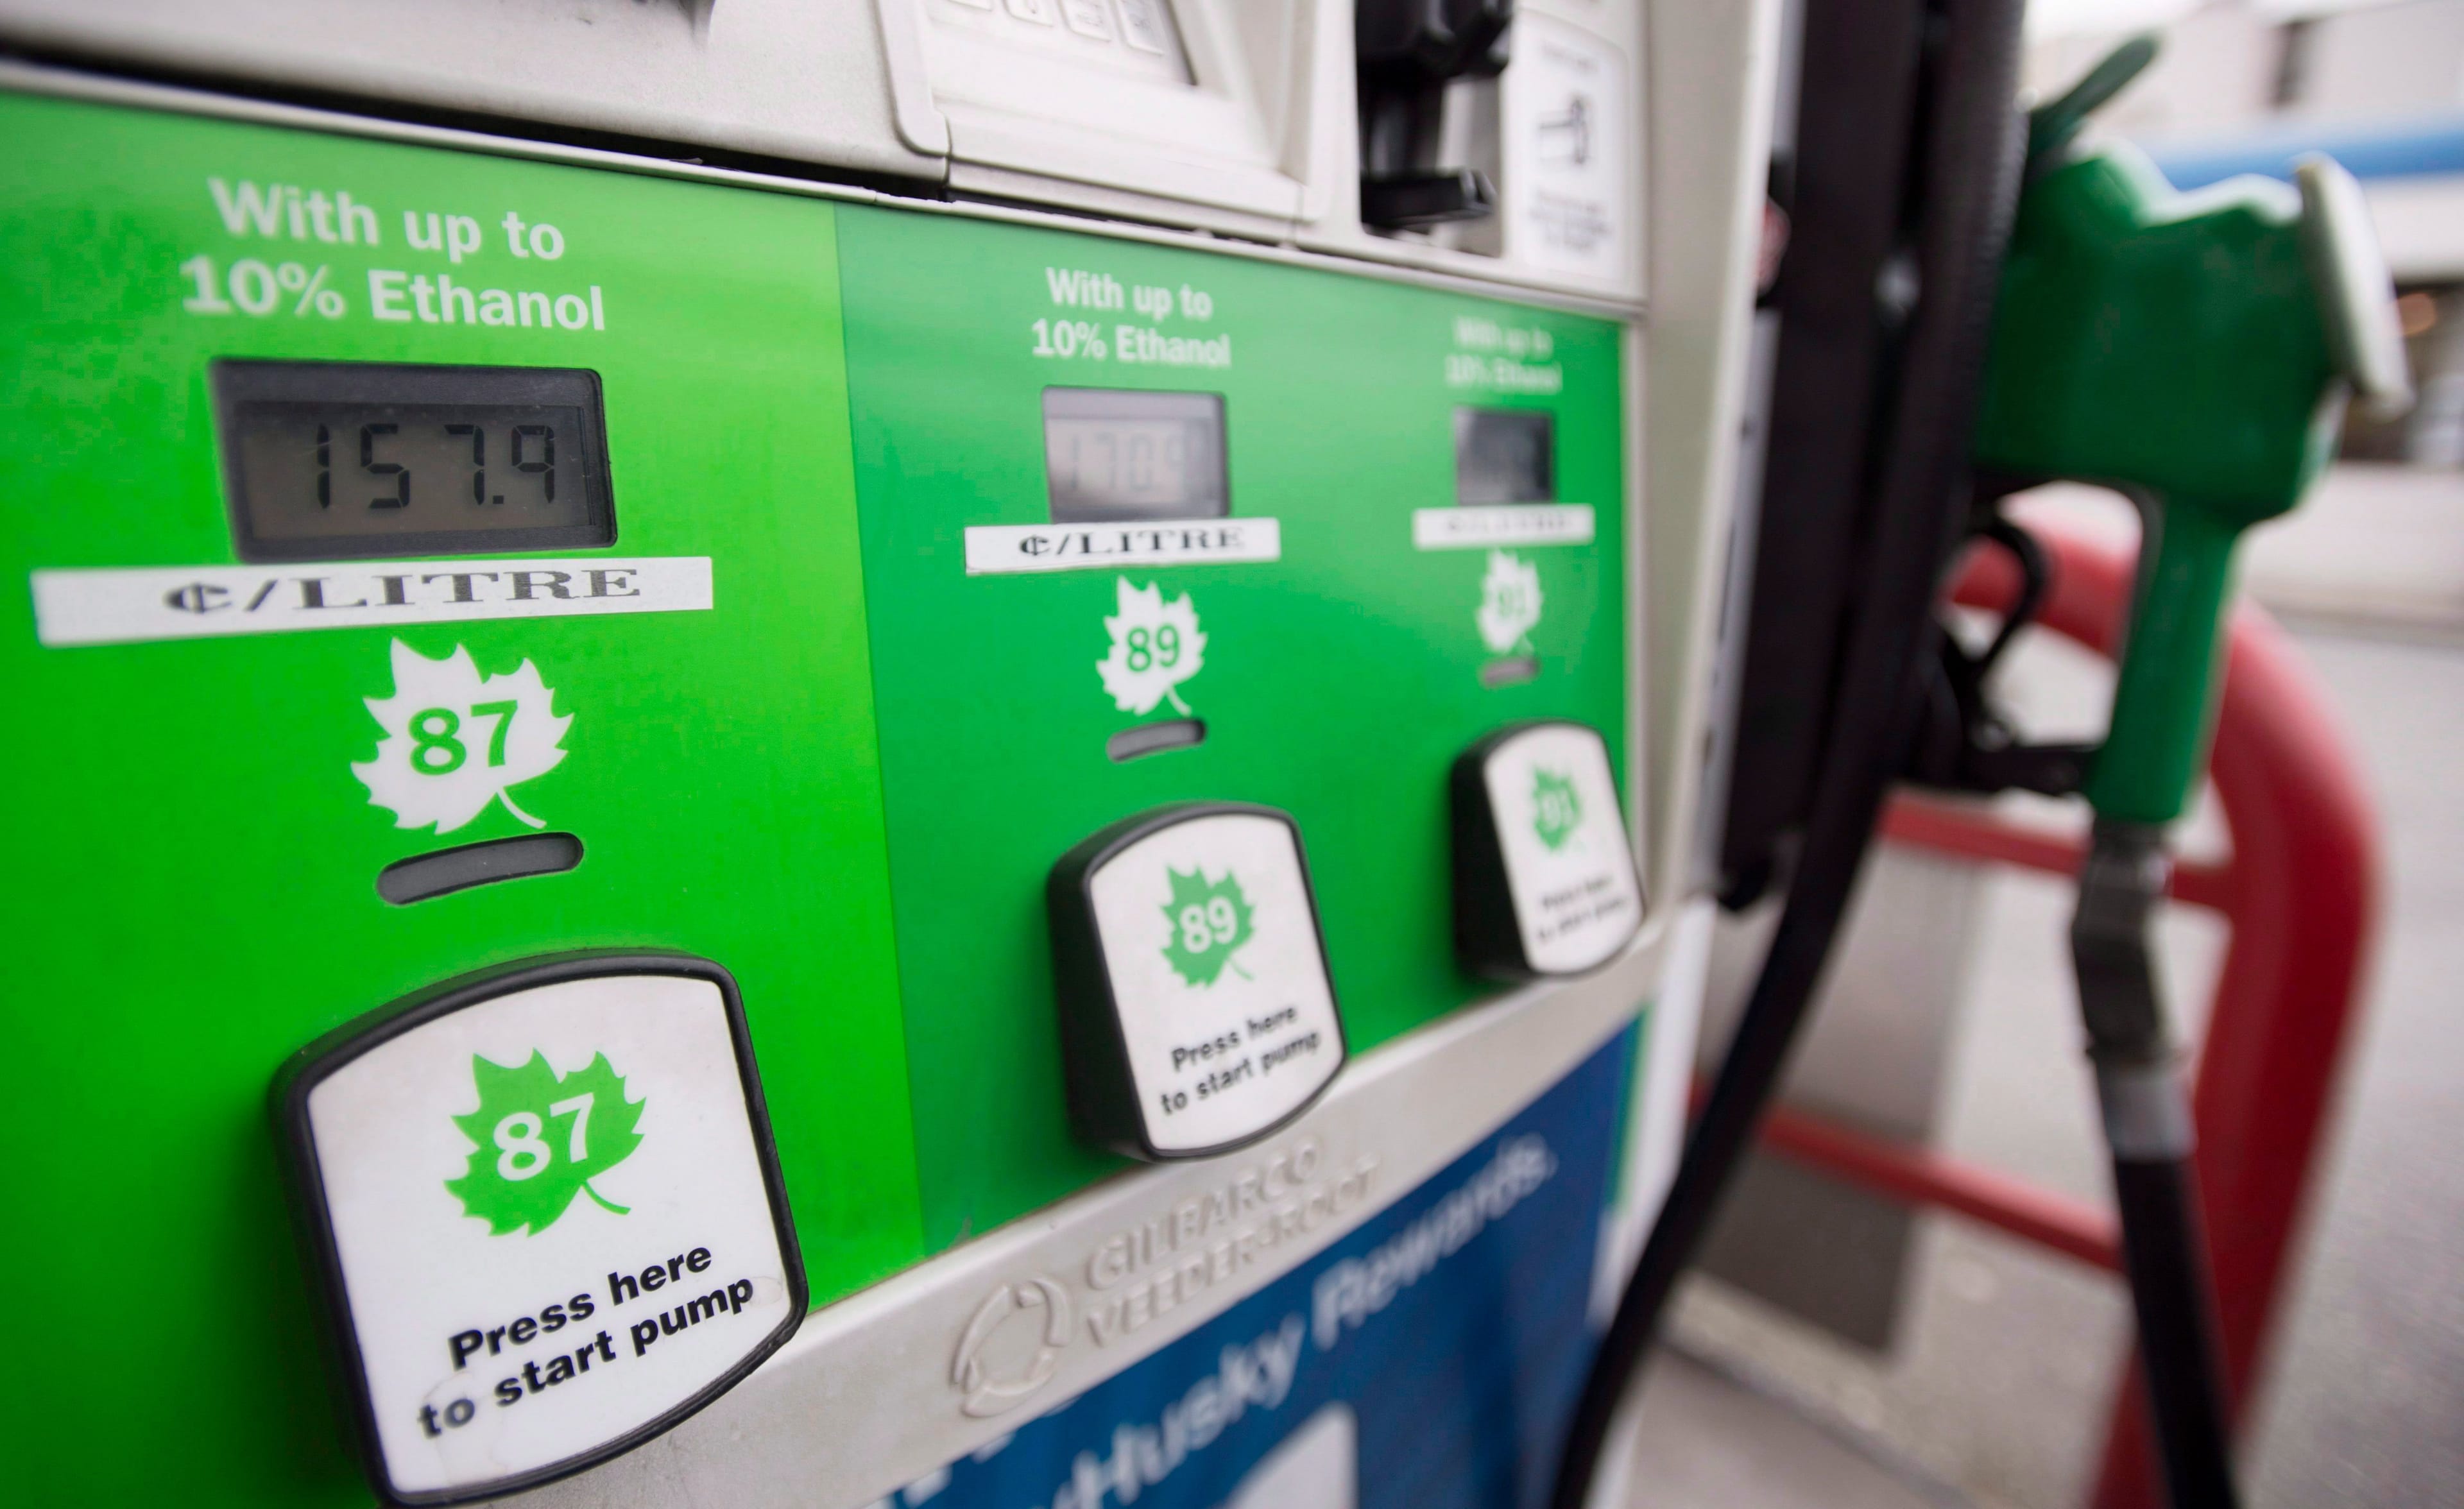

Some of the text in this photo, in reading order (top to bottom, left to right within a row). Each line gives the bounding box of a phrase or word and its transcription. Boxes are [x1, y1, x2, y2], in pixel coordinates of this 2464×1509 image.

[207, 176, 566, 262] With up to
[180, 255, 606, 330] 10% Ethanol
[1045, 267, 1213, 321] With up to
[1031, 318, 1232, 368] 10% Ethanol
[316, 422, 556, 509] 157.9
[1127, 624, 1180, 672] 89
[408, 699, 518, 776] 87
[1179, 896, 1238, 953] 89
[1159, 1030, 1321, 1116] to start pump
[1169, 1006, 1297, 1073] Press here
[492, 1092, 595, 1182] 87
[447, 1246, 714, 1371] Press here
[416, 1277, 754, 1439] to start pump
